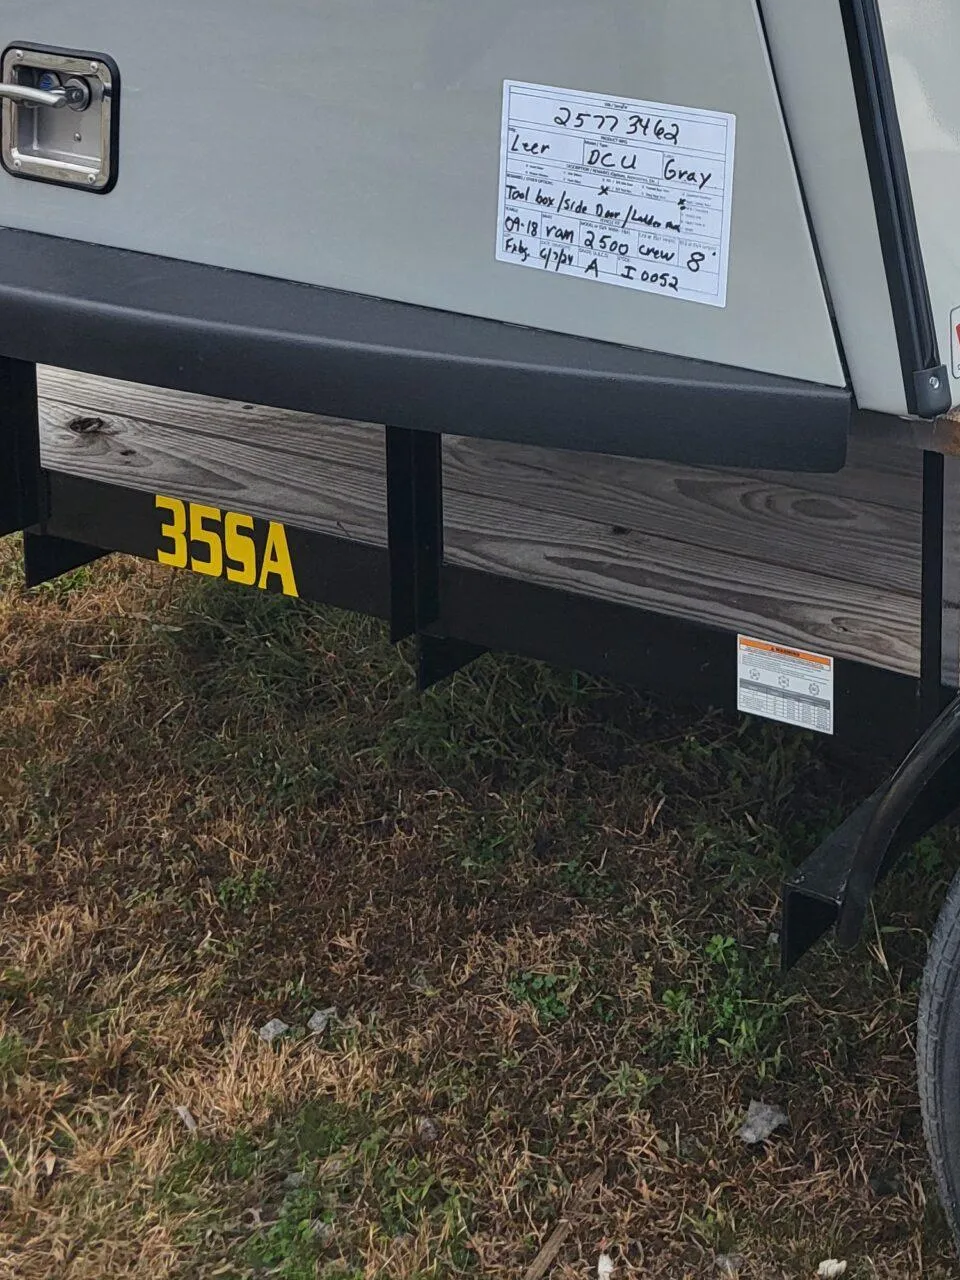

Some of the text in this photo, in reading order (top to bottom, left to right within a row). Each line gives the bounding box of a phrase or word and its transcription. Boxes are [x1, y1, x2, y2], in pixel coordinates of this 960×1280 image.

[510, 133, 551, 155] Leer
[663, 158, 712, 190] Gray
[583, 230, 630, 256] 2500
[638, 244, 676, 262] crew
[584, 258, 599, 278] A
